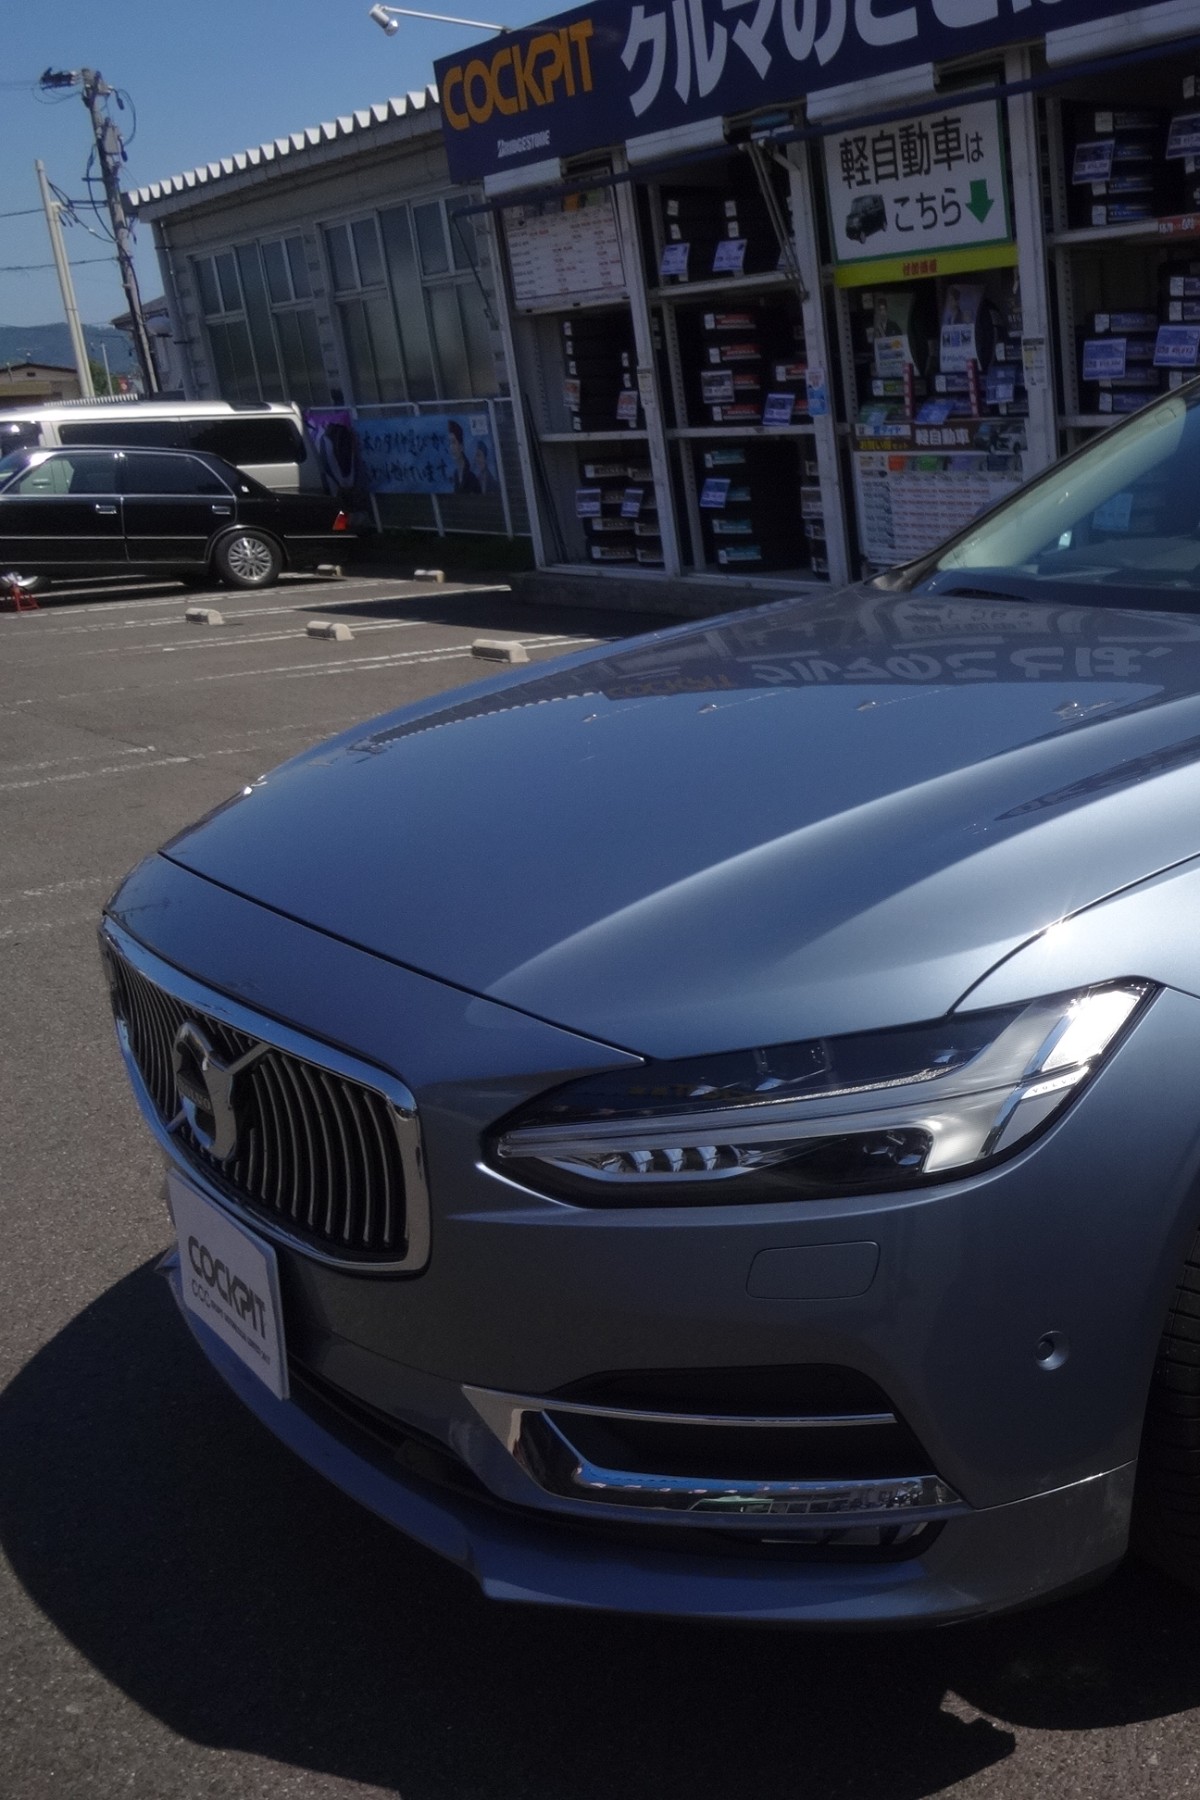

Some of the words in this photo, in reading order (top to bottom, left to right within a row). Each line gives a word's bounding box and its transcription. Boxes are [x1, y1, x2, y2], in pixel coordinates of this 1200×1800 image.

[443, 18, 594, 130] COCKPIT
[839, 116, 984, 189] 軽自動車は
[894, 188, 962, 232] こちら
[188, 1235, 266, 1340] COCKPIT
